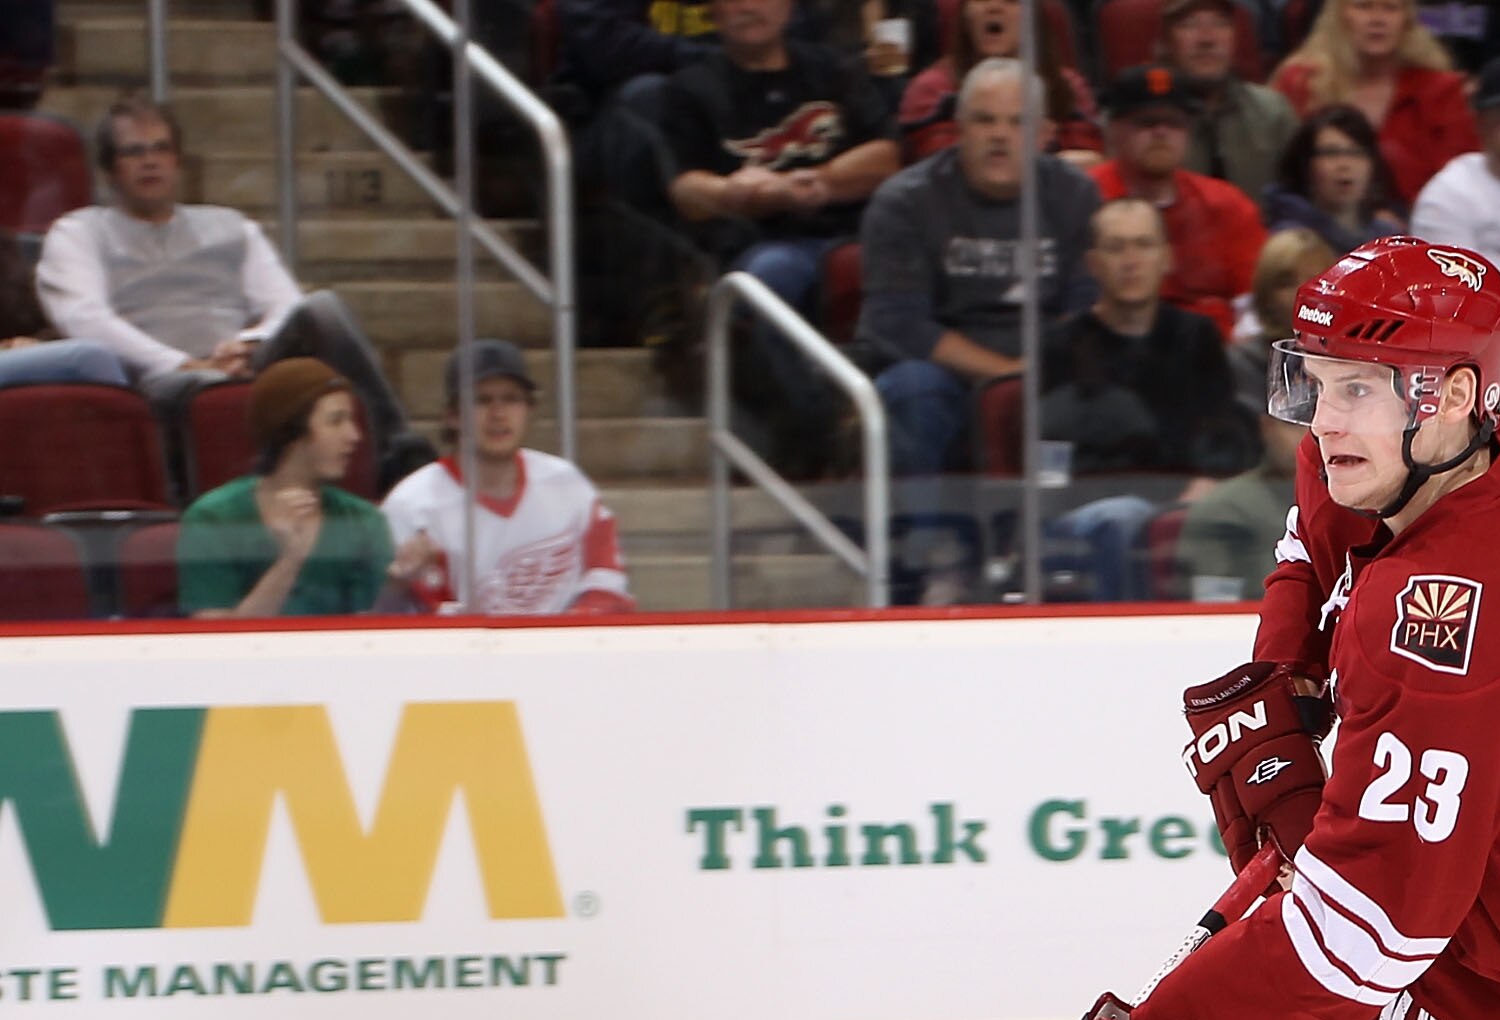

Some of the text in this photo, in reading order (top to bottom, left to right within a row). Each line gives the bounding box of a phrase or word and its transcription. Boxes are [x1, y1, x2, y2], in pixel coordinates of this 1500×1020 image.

[1297, 304, 1335, 327] Reebok
[1404, 622, 1462, 650] PHX
[1358, 731, 1470, 843] 23
[686, 797, 1229, 871] Think Gre
[104, 953, 568, 998] MANAGEMENT
